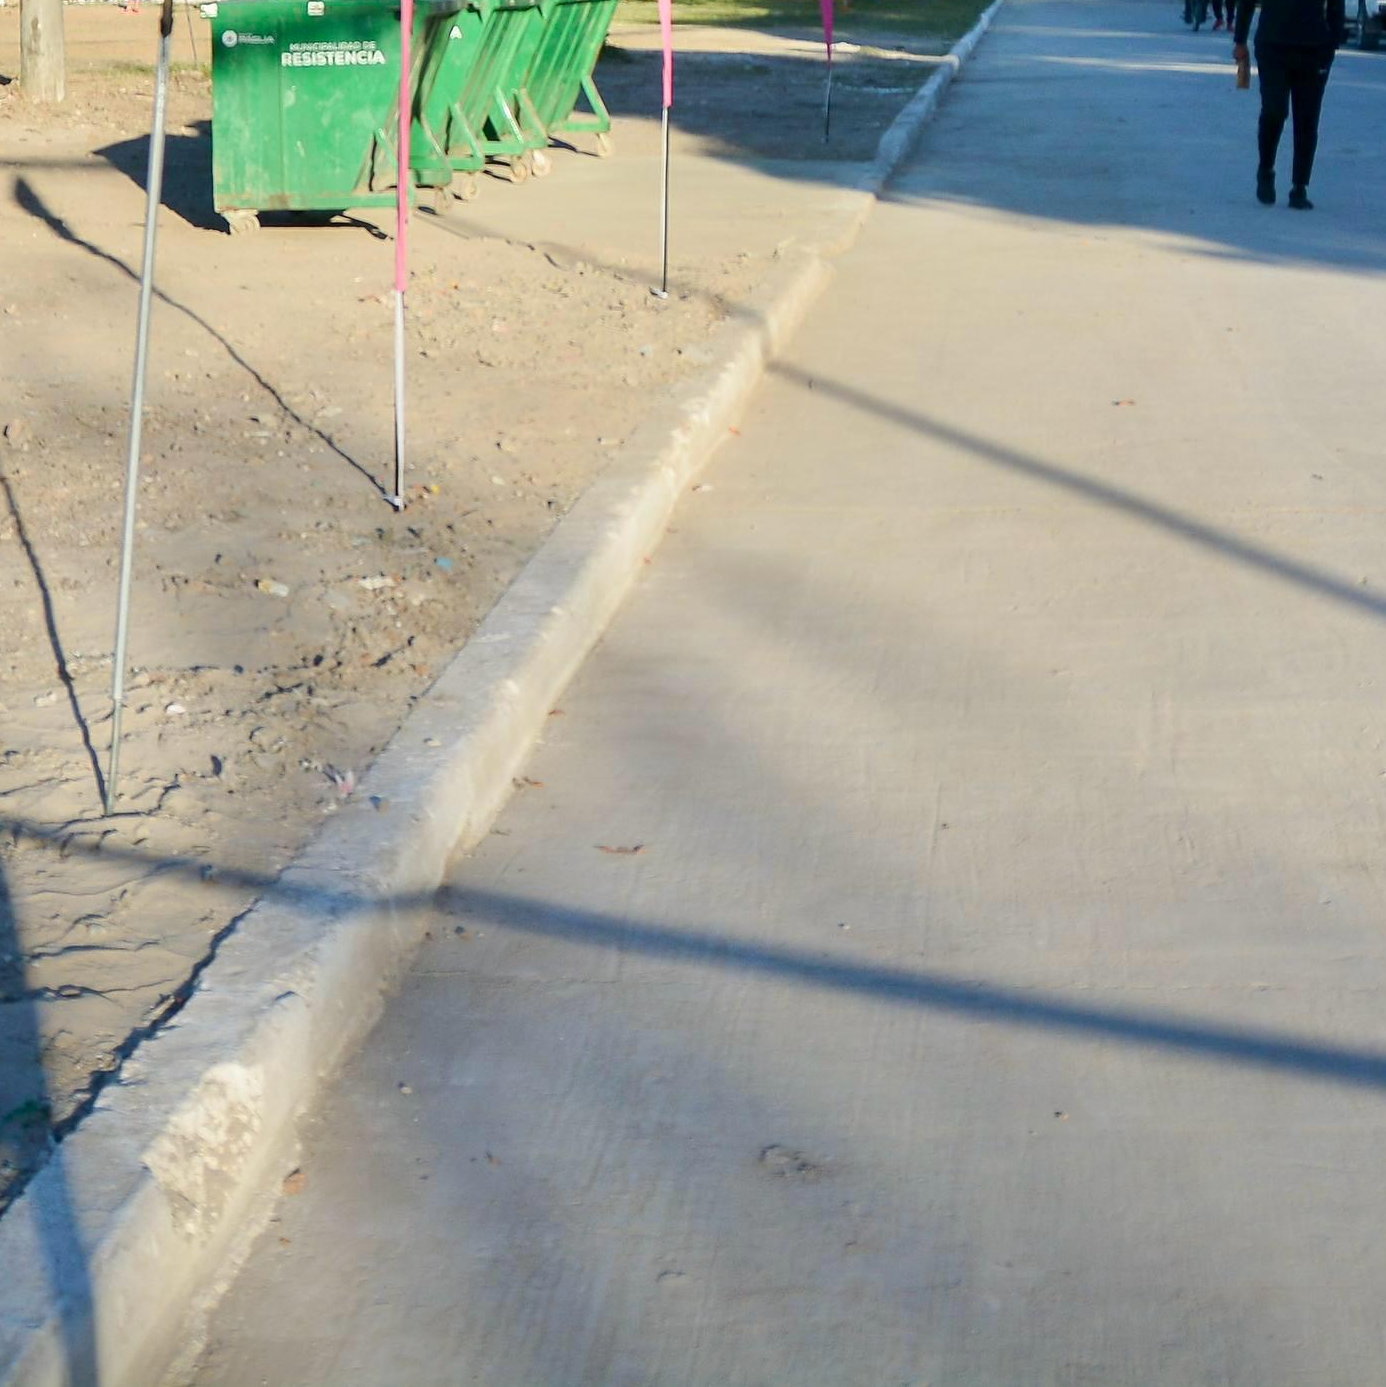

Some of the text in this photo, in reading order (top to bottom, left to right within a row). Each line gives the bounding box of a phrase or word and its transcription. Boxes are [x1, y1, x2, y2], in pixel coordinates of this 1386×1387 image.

[289, 41, 376, 52] MUNICIPALIDAD DE
[281, 50, 386, 67] RESISTENCIA
